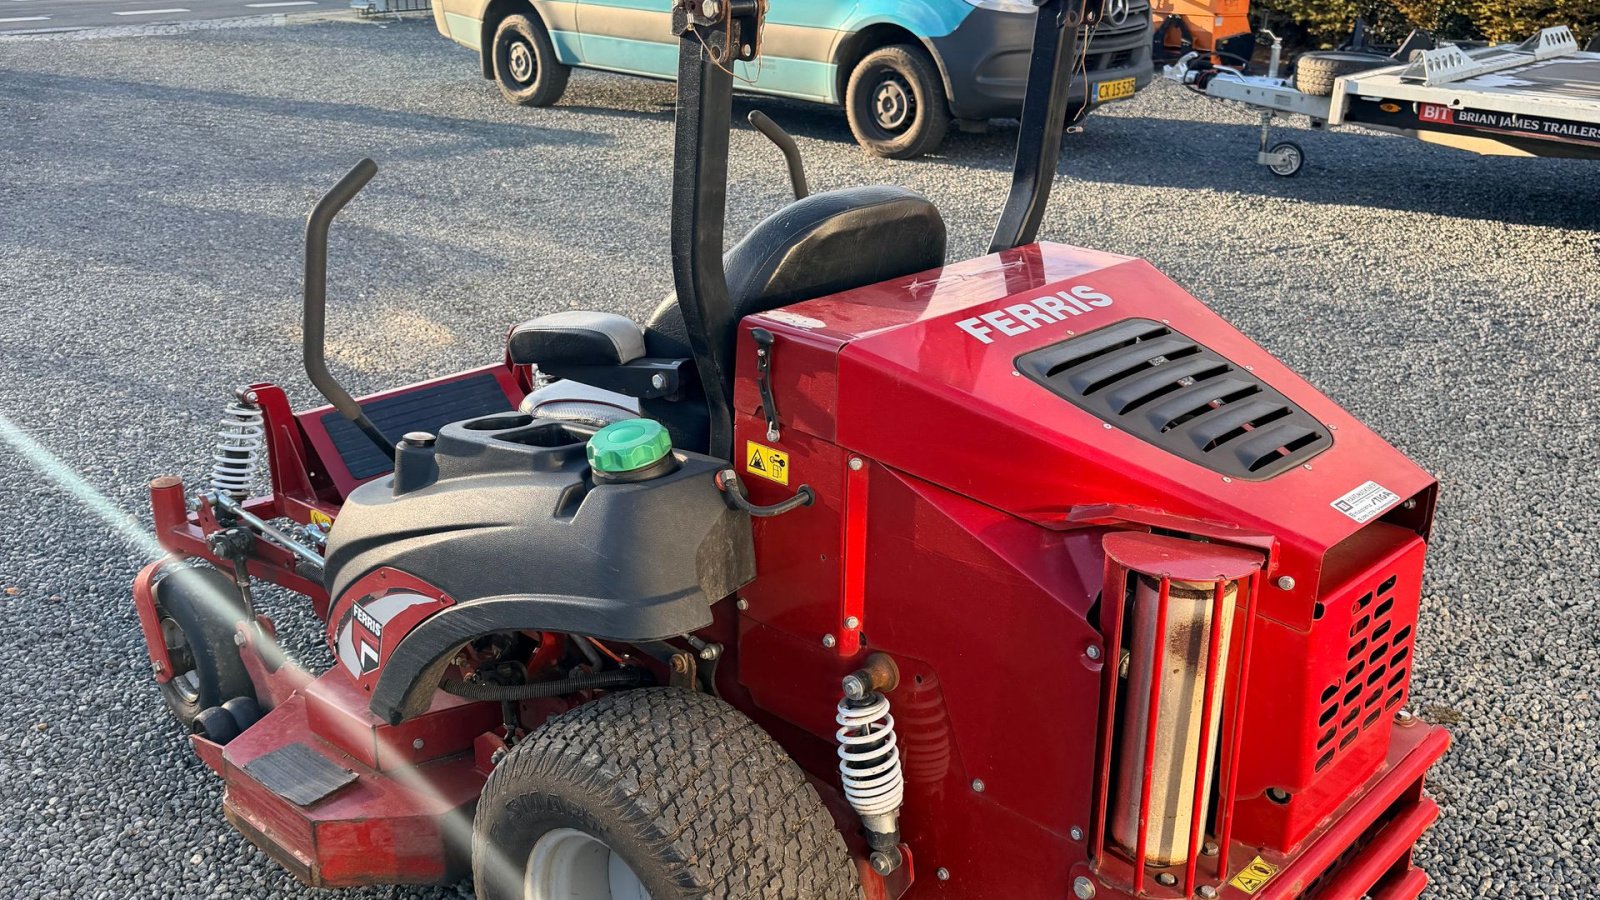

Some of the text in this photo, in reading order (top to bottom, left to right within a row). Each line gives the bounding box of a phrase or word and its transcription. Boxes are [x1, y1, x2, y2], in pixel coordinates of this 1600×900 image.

[1099, 79, 1136, 99] CX 15 525
[1424, 105, 1451, 120] BJT
[1459, 110, 1497, 125] BRIAN
[1499, 116, 1539, 131] JAMES
[954, 285, 1114, 345] FERRIS
[353, 603, 381, 637] FERRIS
